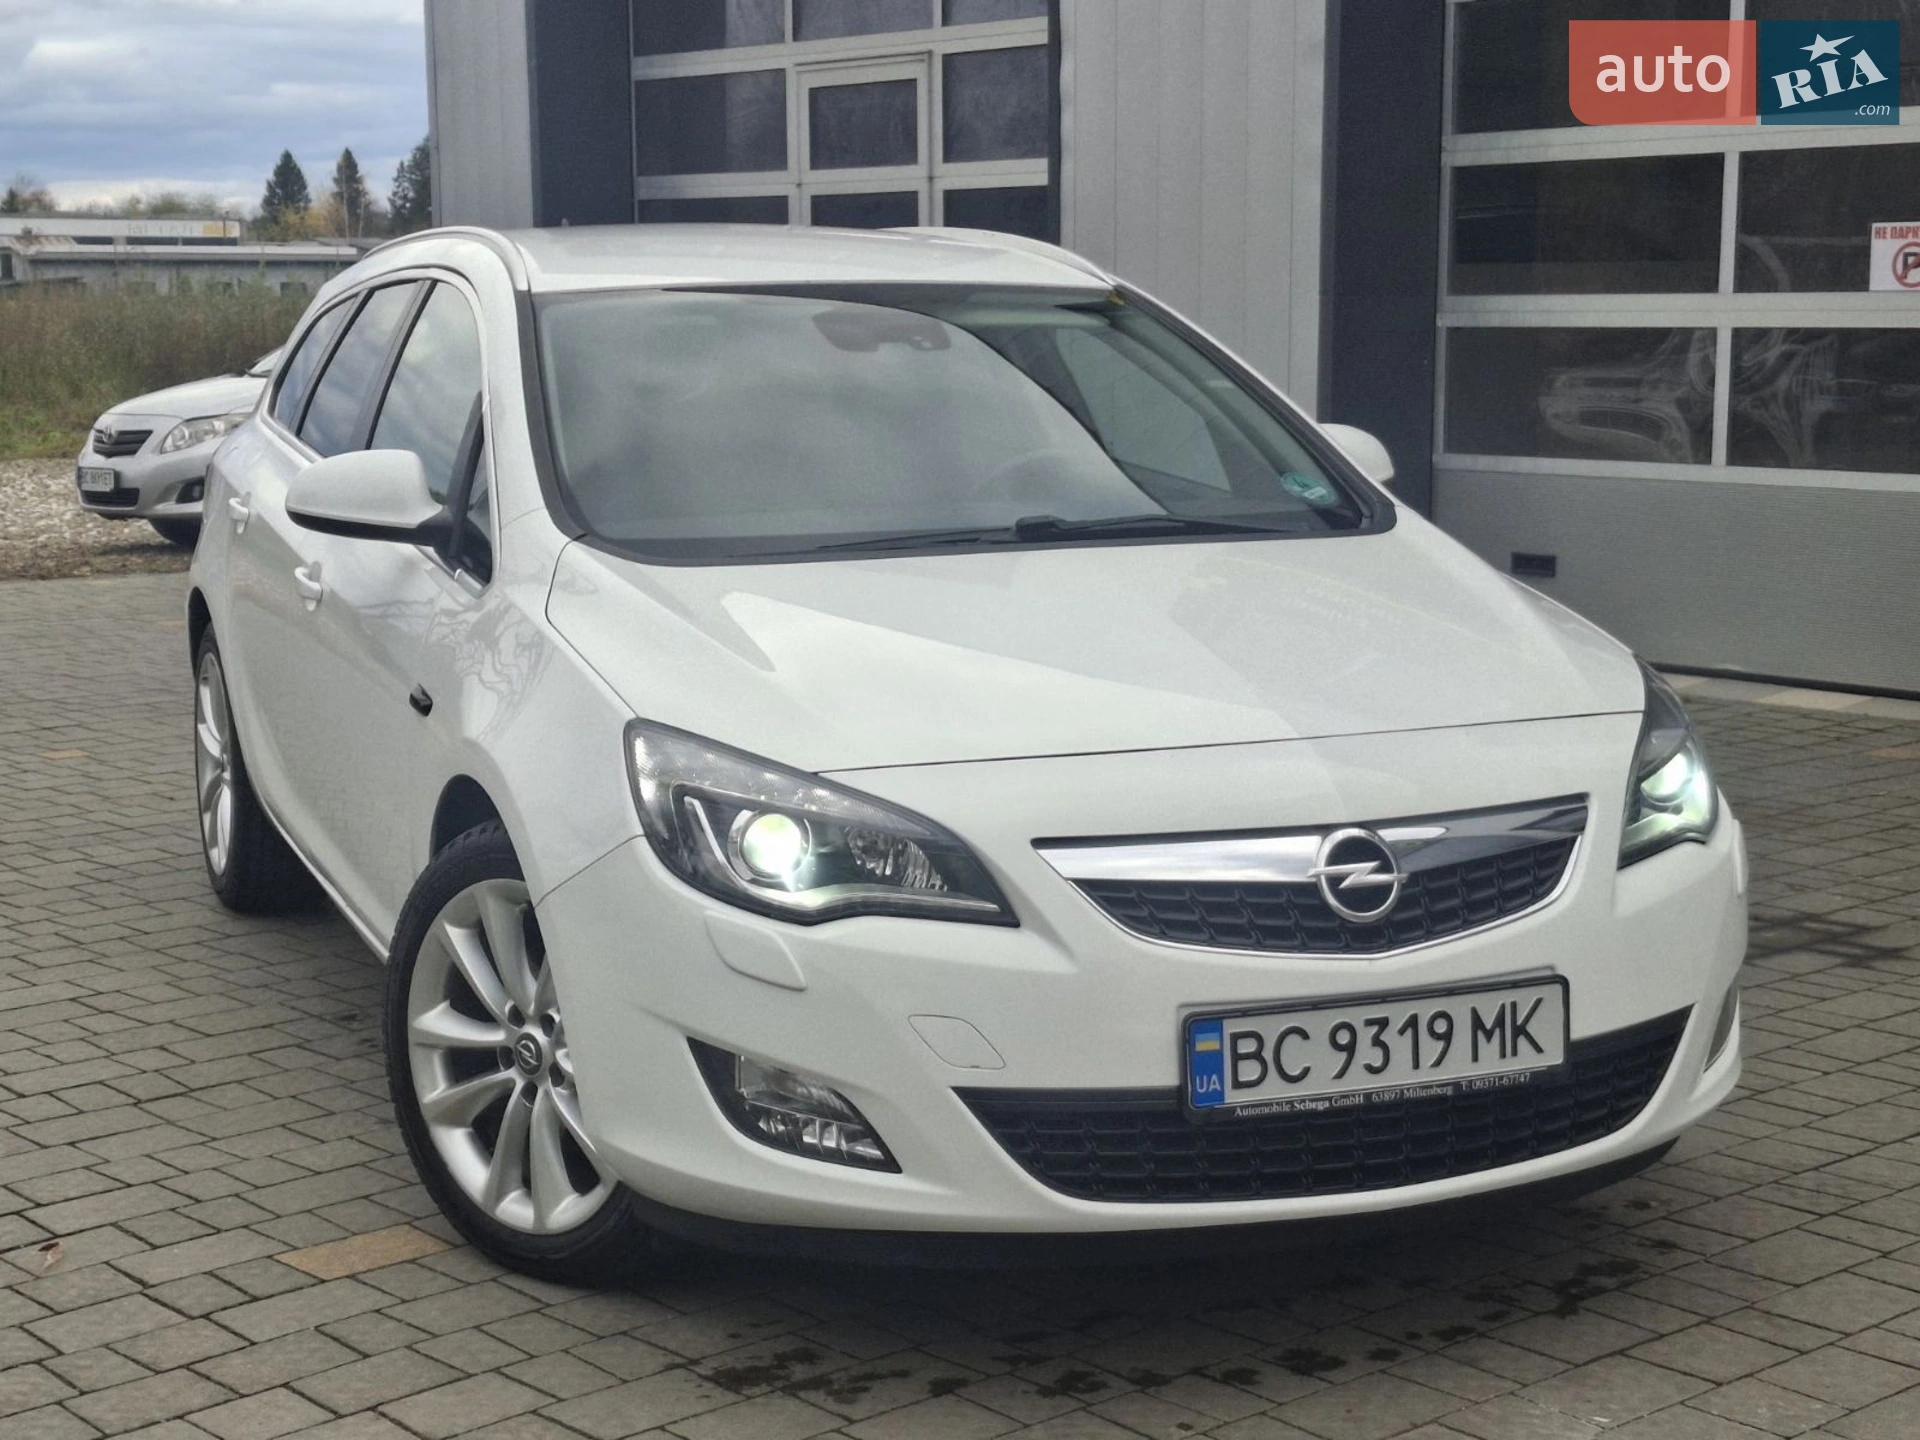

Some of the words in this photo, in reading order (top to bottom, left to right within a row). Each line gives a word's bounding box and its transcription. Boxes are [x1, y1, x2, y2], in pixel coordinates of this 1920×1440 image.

[1874, 226, 1888, 239] НЕ
[1890, 225, 1920, 239] ПАРК
[1230, 1025, 1311, 1090] BC
[1328, 1009, 1454, 1080] 9319
[1470, 997, 1544, 1063] MK
[1195, 1074, 1221, 1093] UA
[1234, 1103, 1291, 1117] Automobile
[1332, 1093, 1364, 1106] GmbH
[1372, 1090, 1400, 1102] 63897
